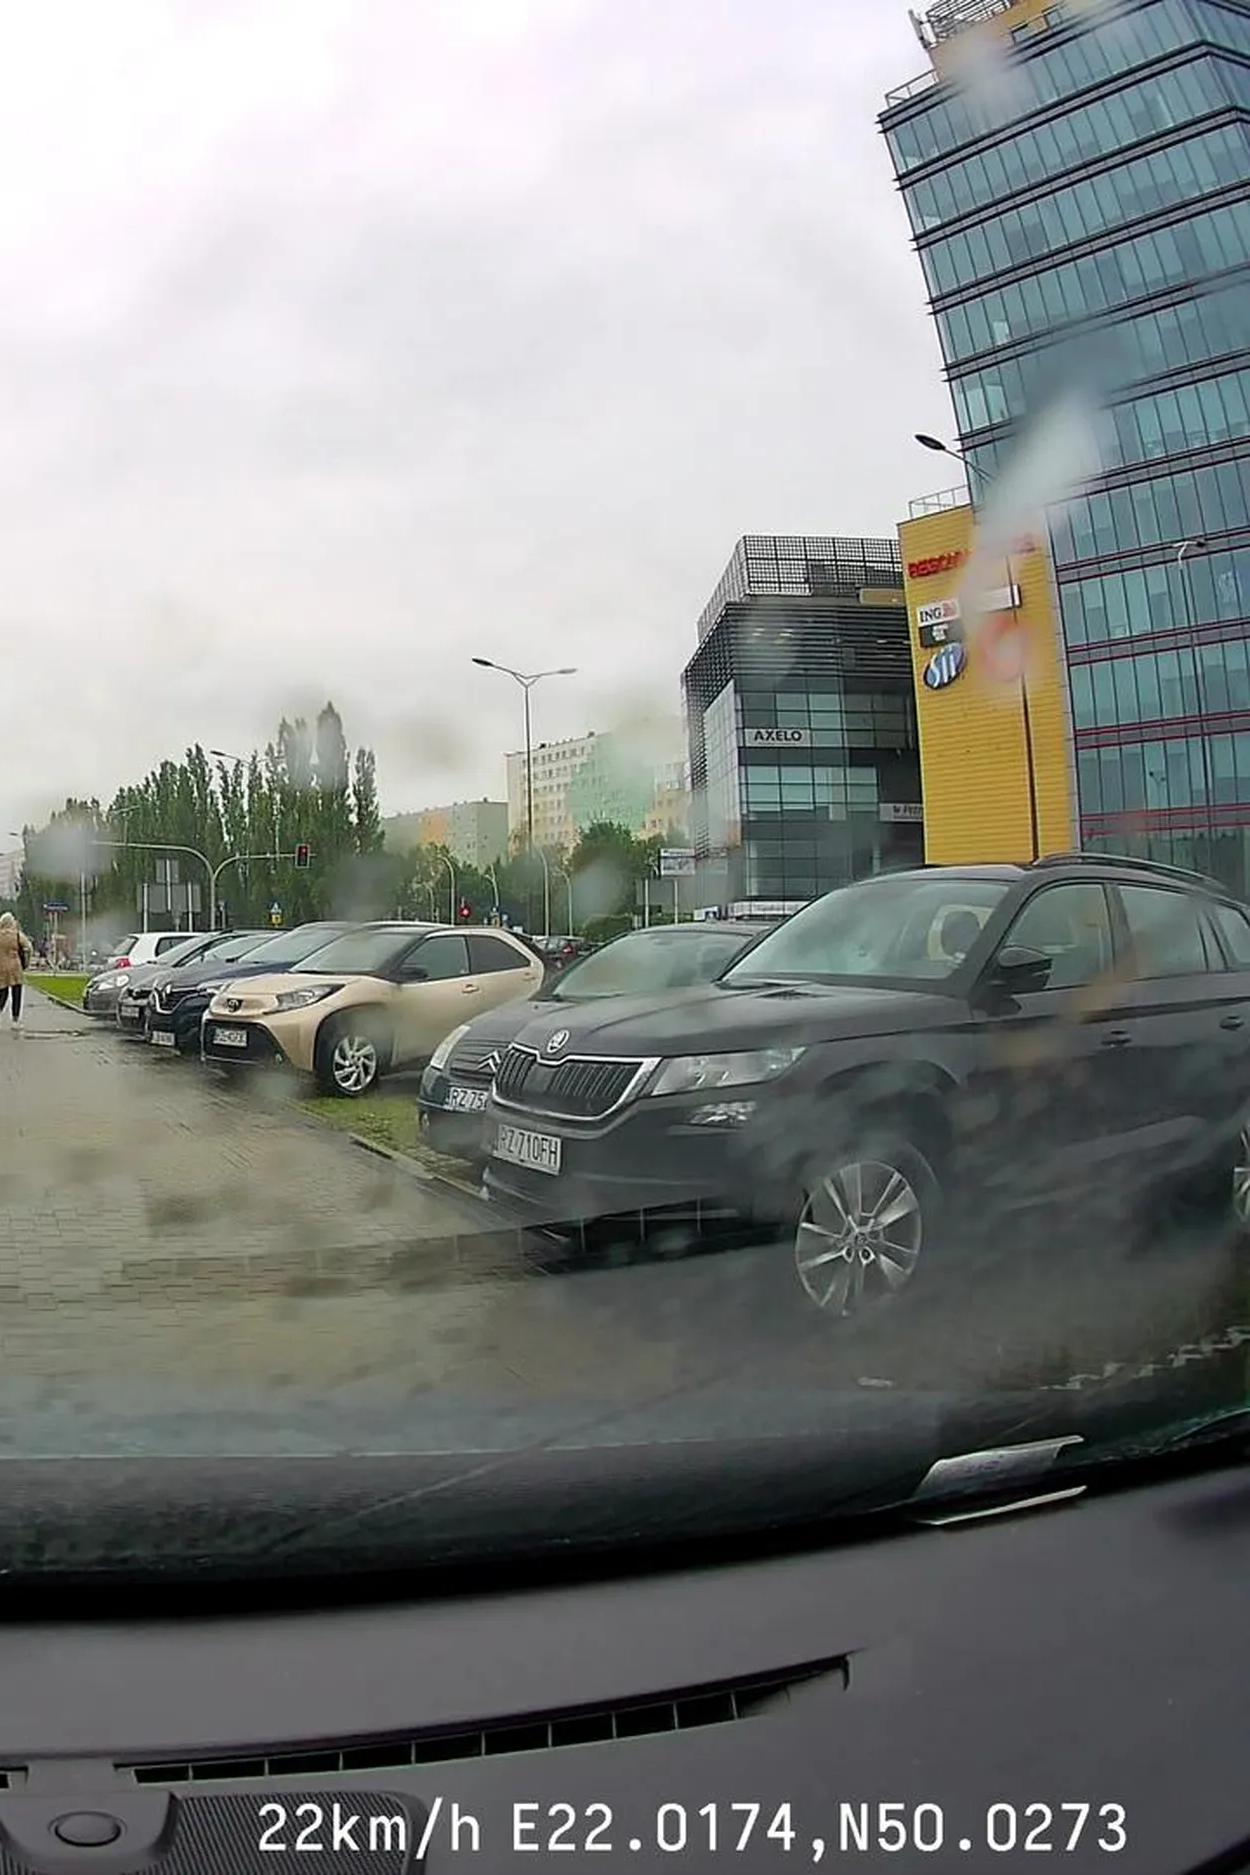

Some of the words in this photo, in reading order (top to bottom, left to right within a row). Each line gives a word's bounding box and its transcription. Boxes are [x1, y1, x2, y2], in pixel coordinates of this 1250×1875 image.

[919, 606, 943, 623] ING
[754, 730, 803, 742] AXELO
[451, 1088, 468, 1107] RZ
[469, 1091, 488, 1109] 75
